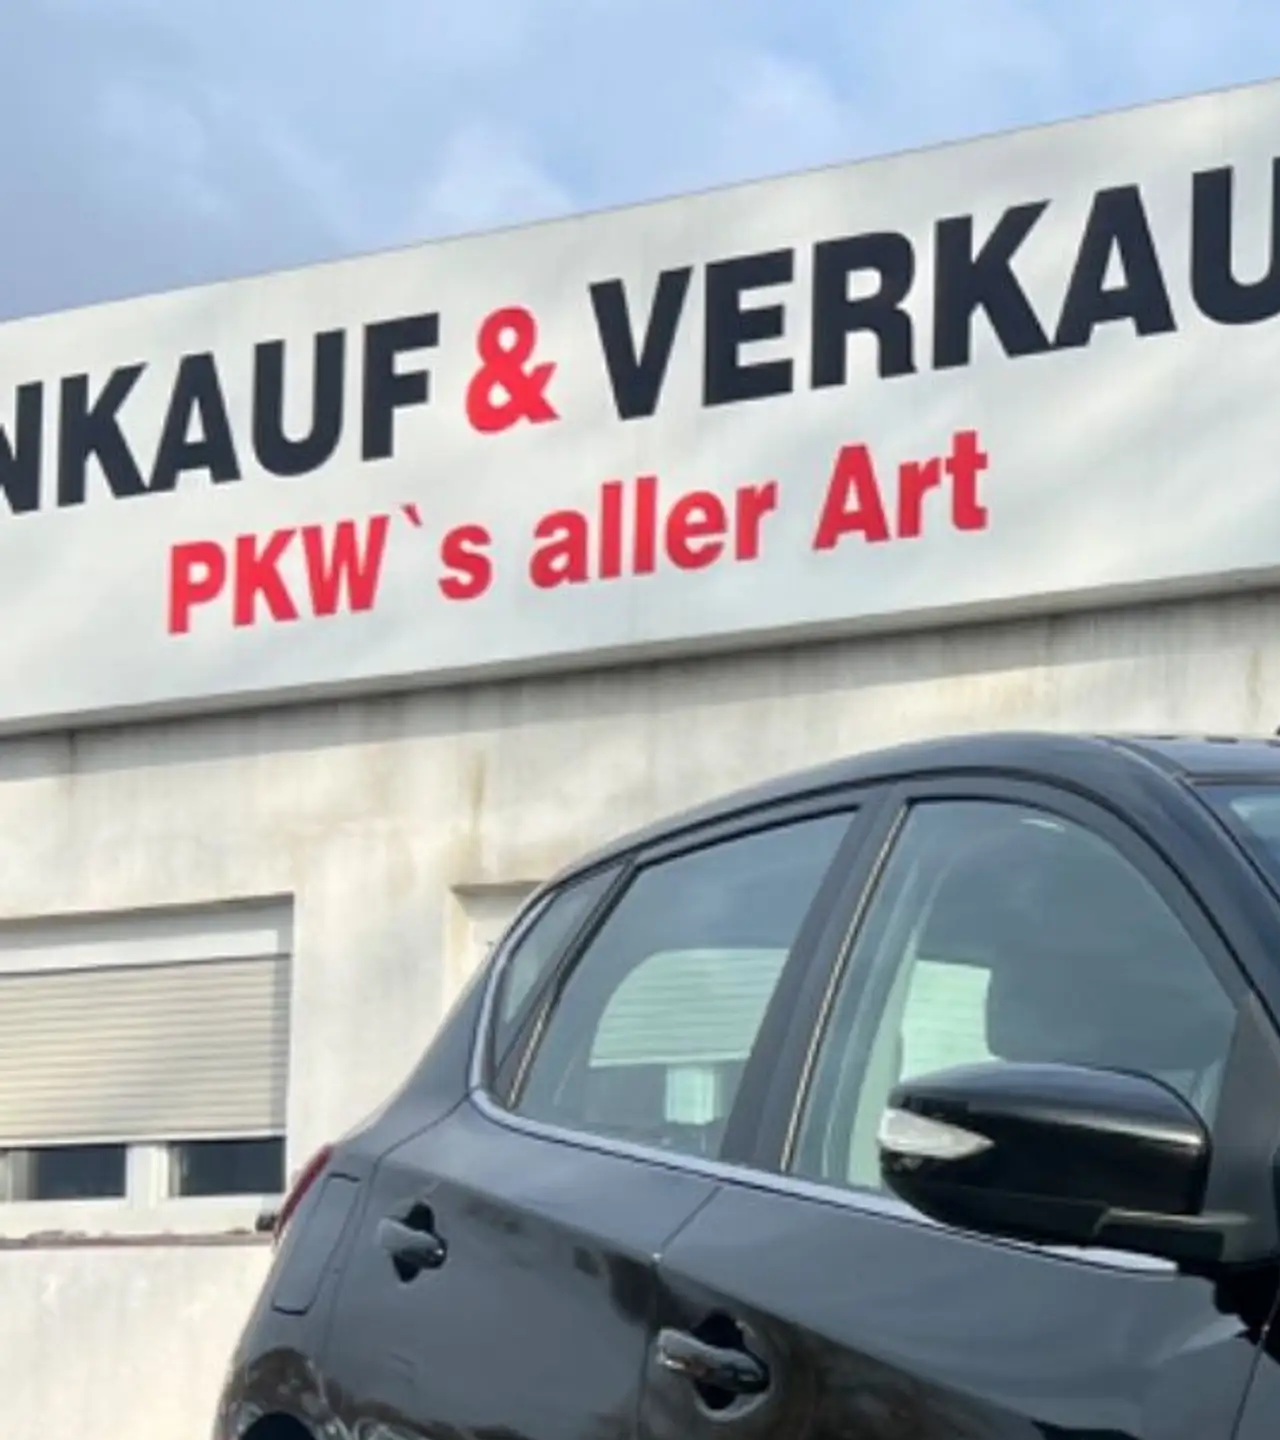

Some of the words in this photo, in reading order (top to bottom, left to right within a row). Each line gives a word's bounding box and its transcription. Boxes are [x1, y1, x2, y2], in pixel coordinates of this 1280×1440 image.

[464, 306, 557, 435] &
[530, 475, 778, 589] aller
[814, 430, 989, 550] Art
